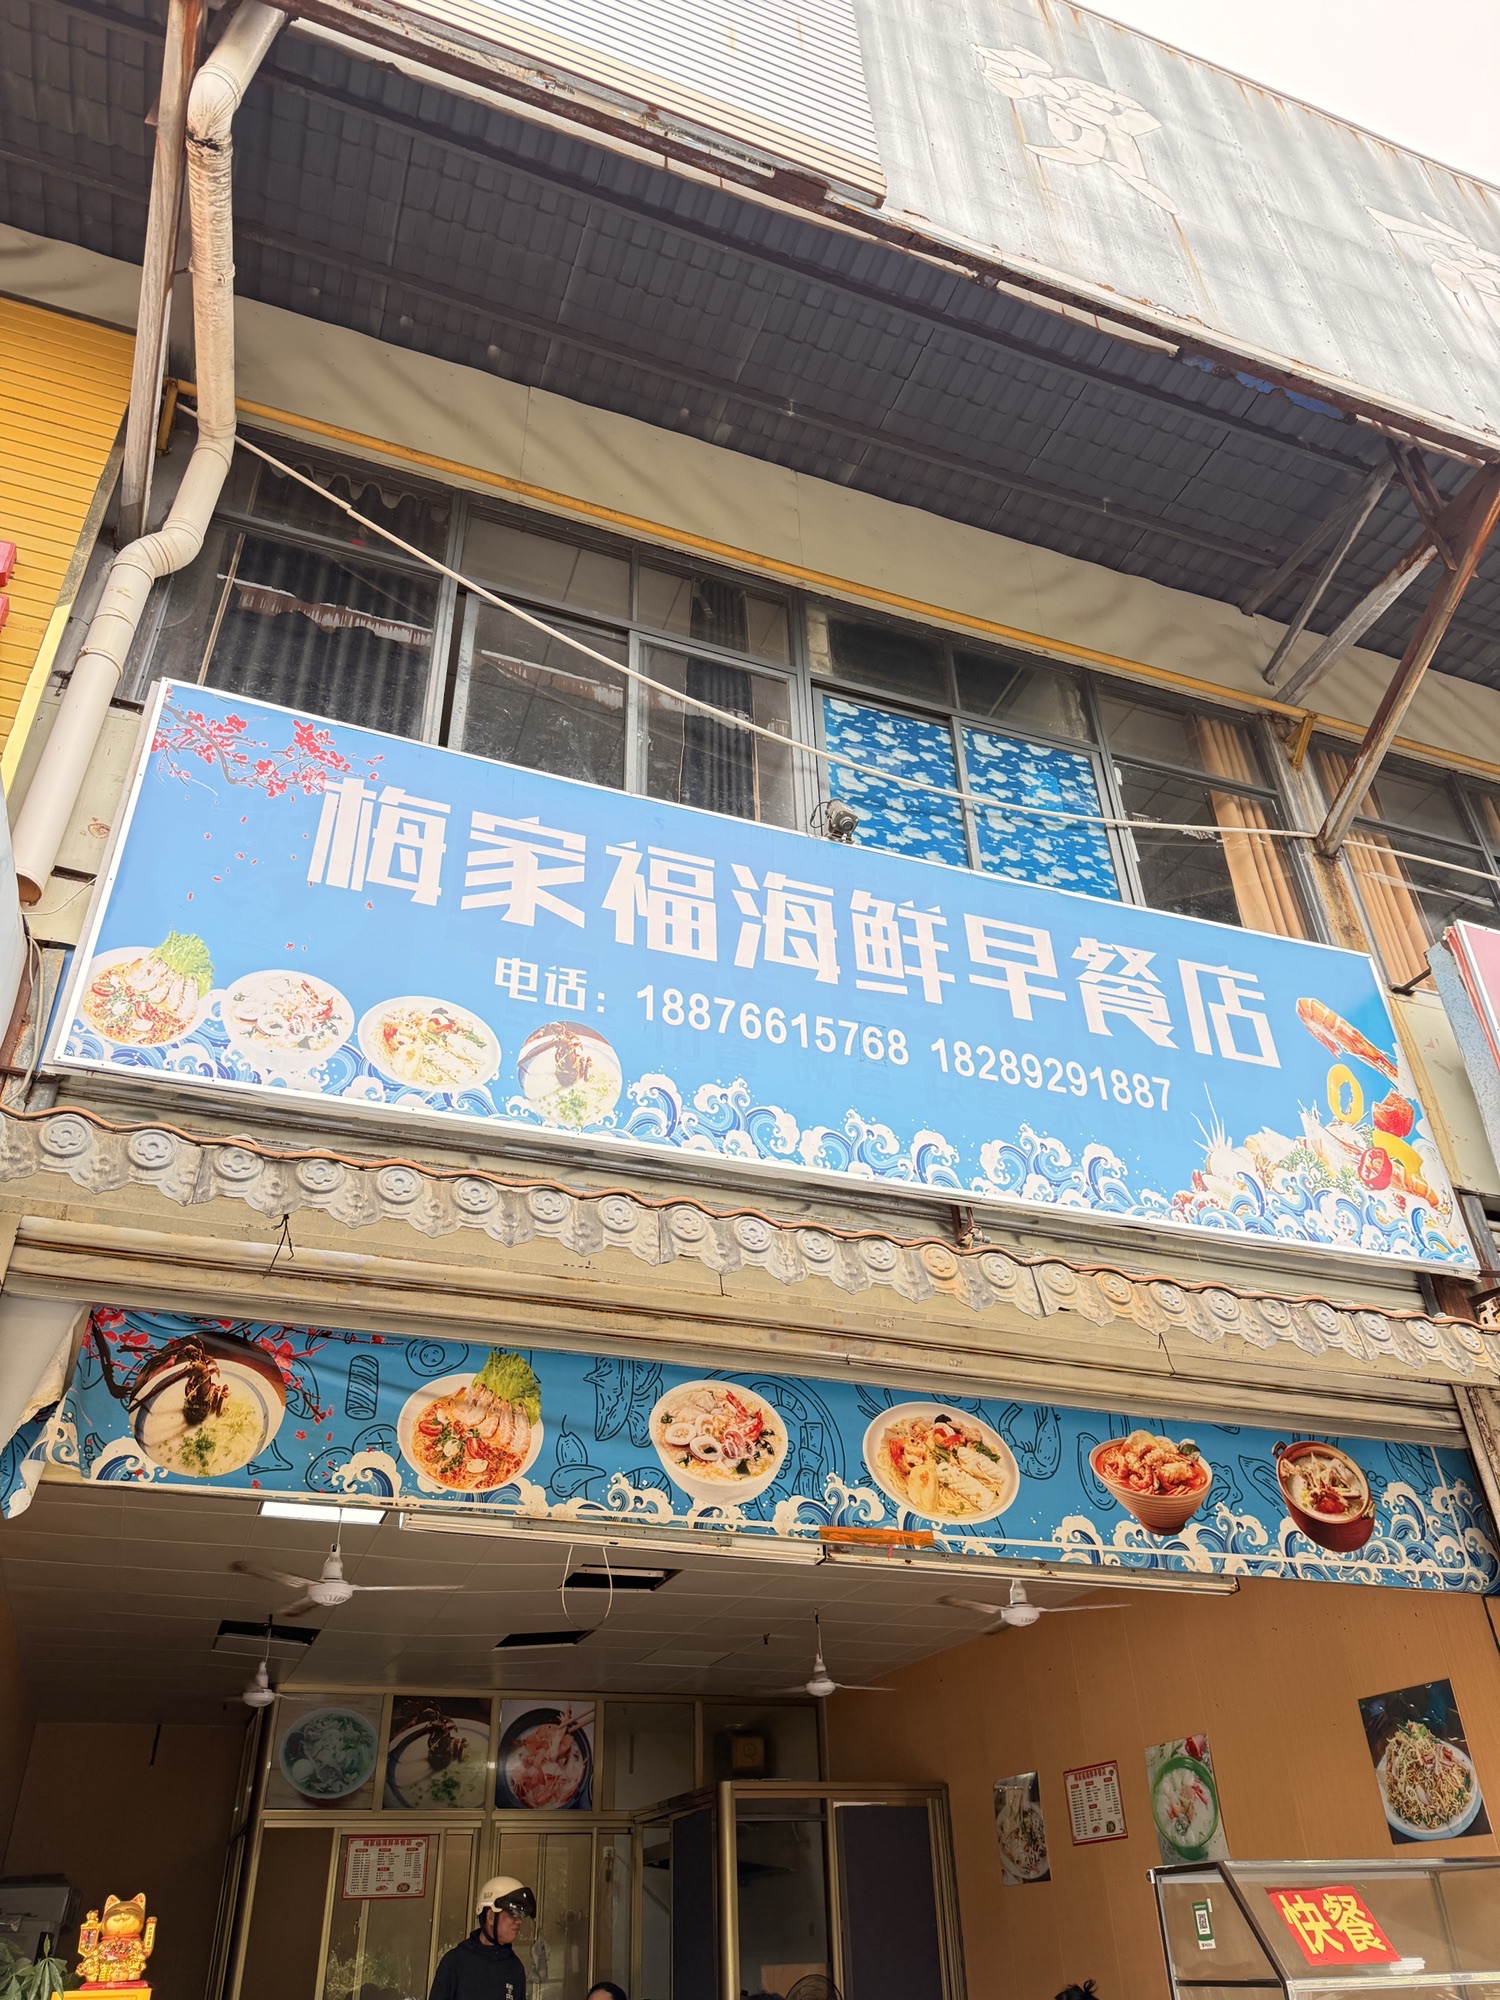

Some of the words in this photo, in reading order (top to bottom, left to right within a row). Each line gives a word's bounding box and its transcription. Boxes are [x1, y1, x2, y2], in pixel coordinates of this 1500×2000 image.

[307, 777, 1282, 1068] 梅家福海鲜早餐店
[636, 984, 910, 1066] 18876615768
[930, 1037, 1171, 1111] 18289291887
[1277, 1892, 1387, 1955] 快餐
